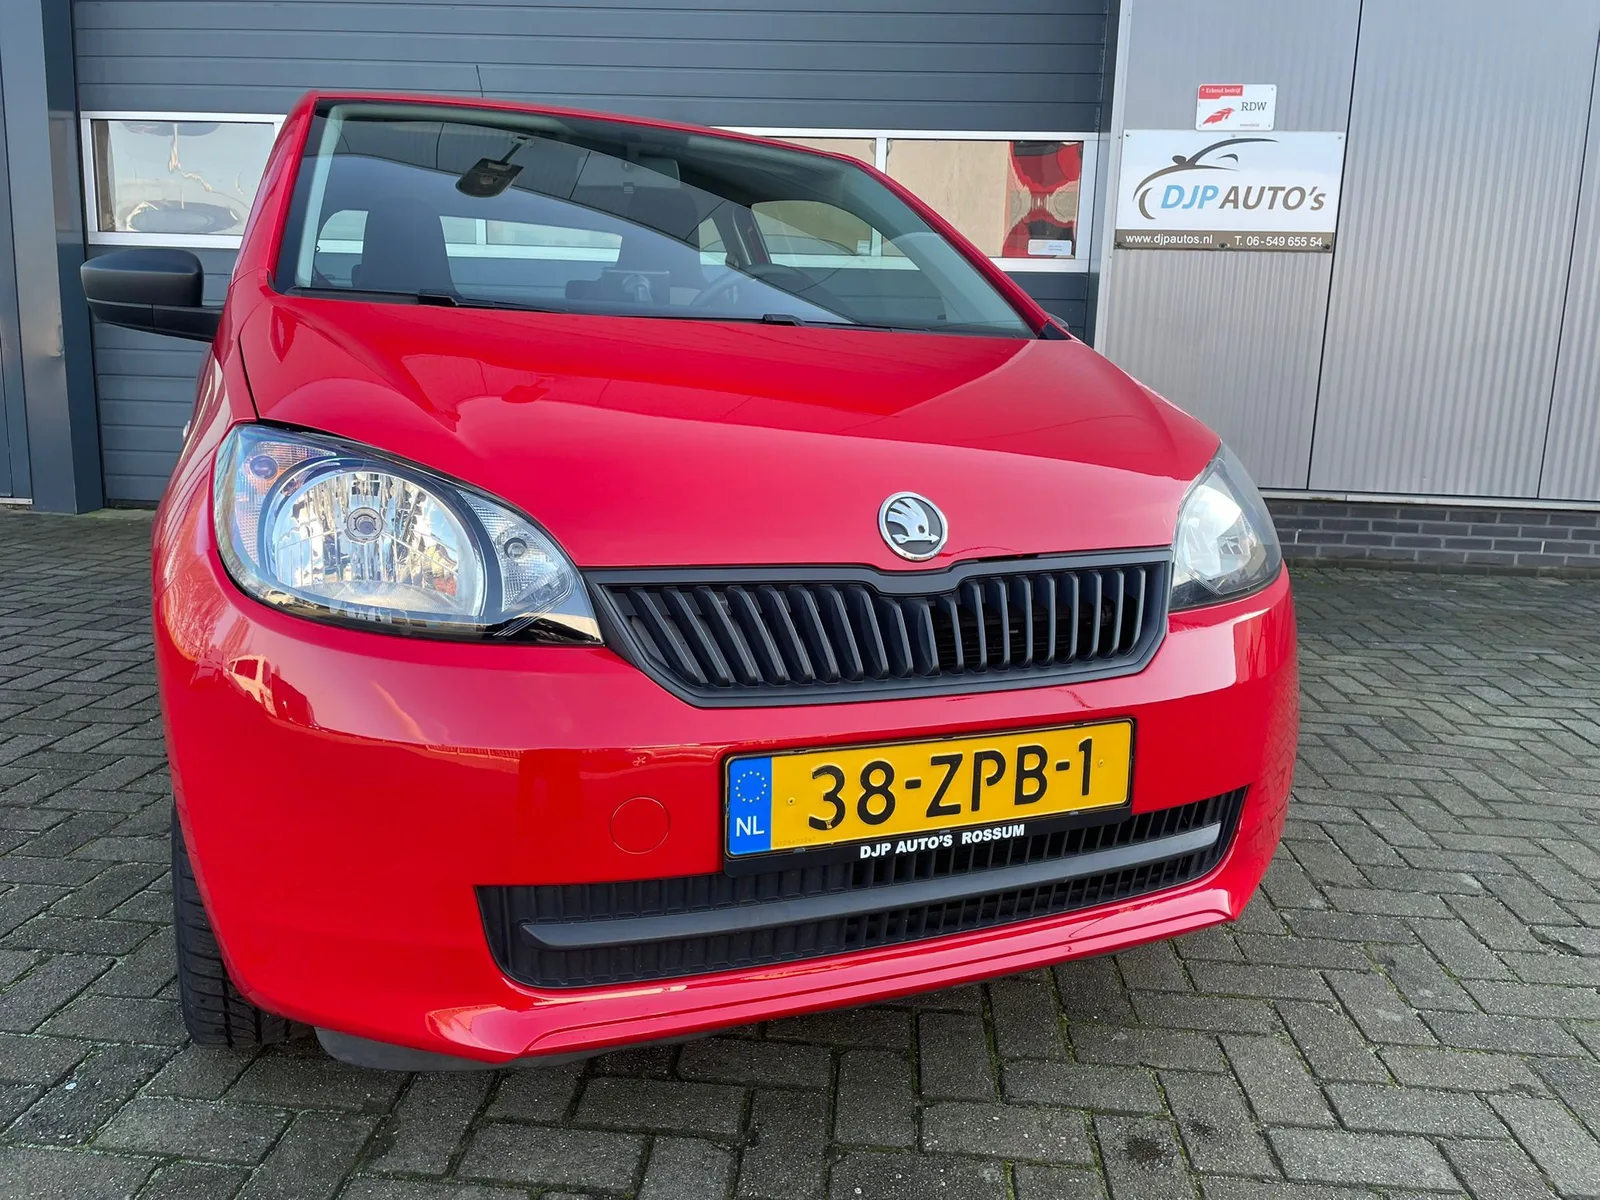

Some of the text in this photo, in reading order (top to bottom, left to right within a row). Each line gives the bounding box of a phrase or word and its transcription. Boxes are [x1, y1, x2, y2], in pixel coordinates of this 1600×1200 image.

[1241, 101, 1267, 112] RDW
[1160, 184, 1327, 211] DJP AUTO's
[1125, 233, 1213, 246] www.djpautos.nl
[1234, 235, 1243, 246] T.
[1287, 236, 1307, 247] 655
[1309, 236, 1323, 247] 54
[807, 736, 1093, 832] 38-ZPB-1
[735, 815, 766, 838] NL
[859, 823, 1026, 859] DJP AUTO'S ROSSUM
